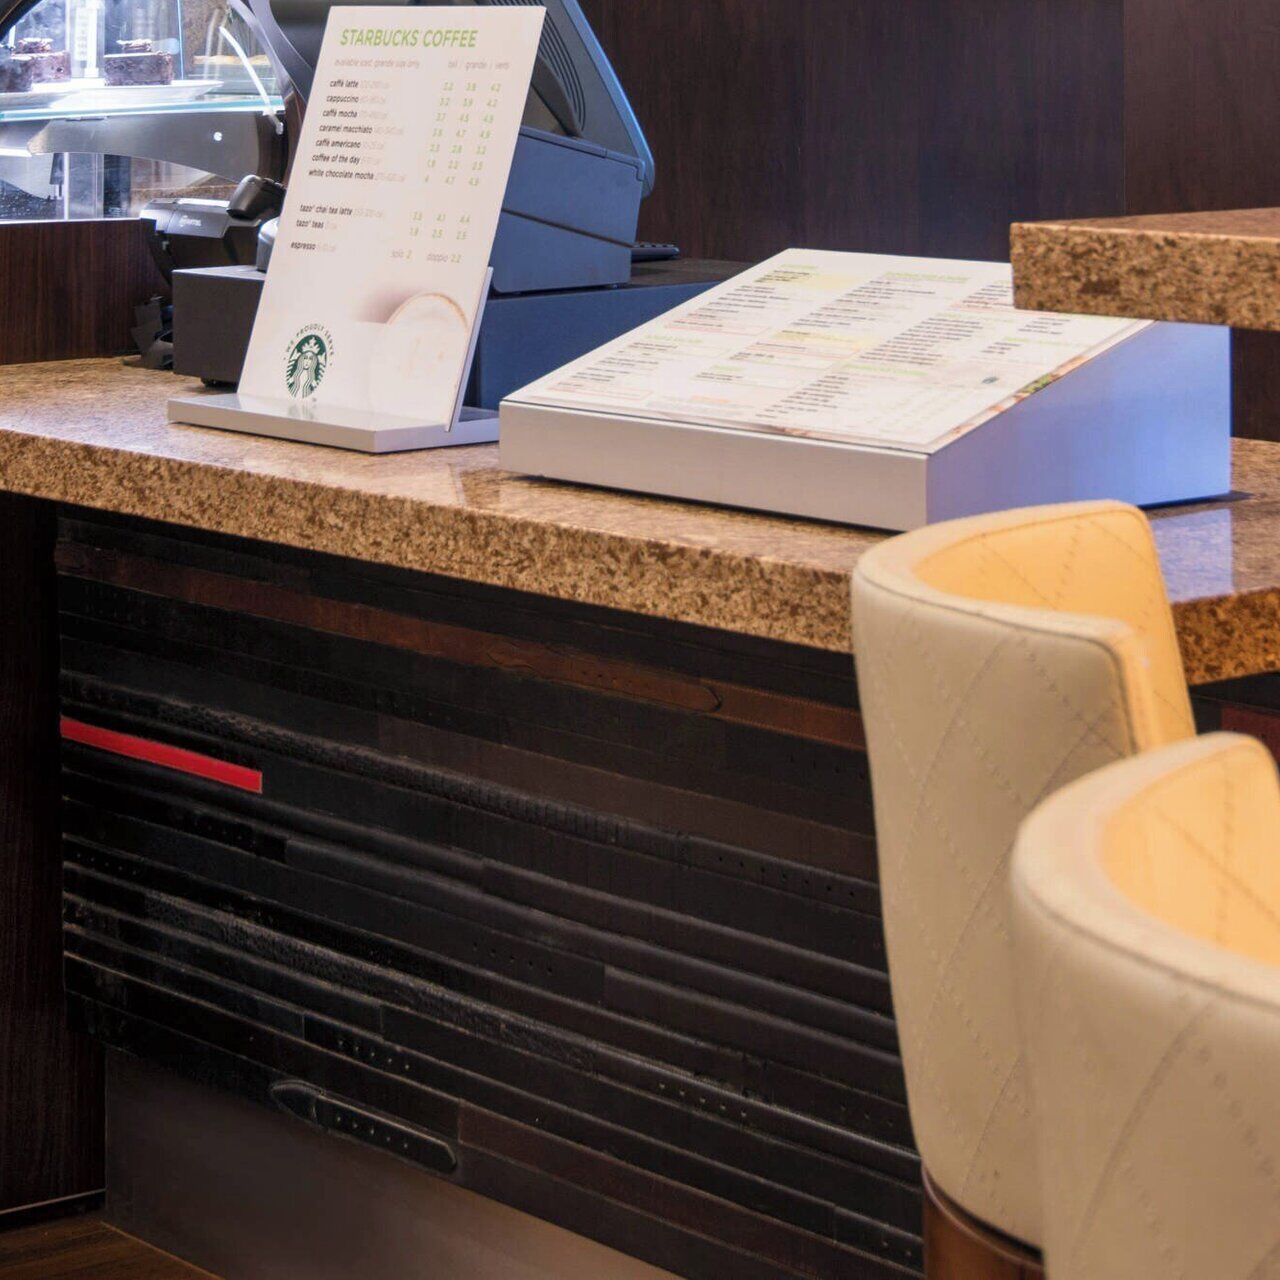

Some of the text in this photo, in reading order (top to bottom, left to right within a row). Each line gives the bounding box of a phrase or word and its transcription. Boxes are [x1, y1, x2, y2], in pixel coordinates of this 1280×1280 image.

[340, 28, 477, 47] STARBUCKS COFFEE
[330, 140, 360, 148] americano
[311, 153, 329, 161] coffee
[331, 153, 338, 162] of
[349, 156, 360, 165] day
[325, 170, 353, 178] chocolate
[328, 206, 338, 214] tea
[338, 207, 352, 215] latte
[290, 241, 315, 249] espresso
